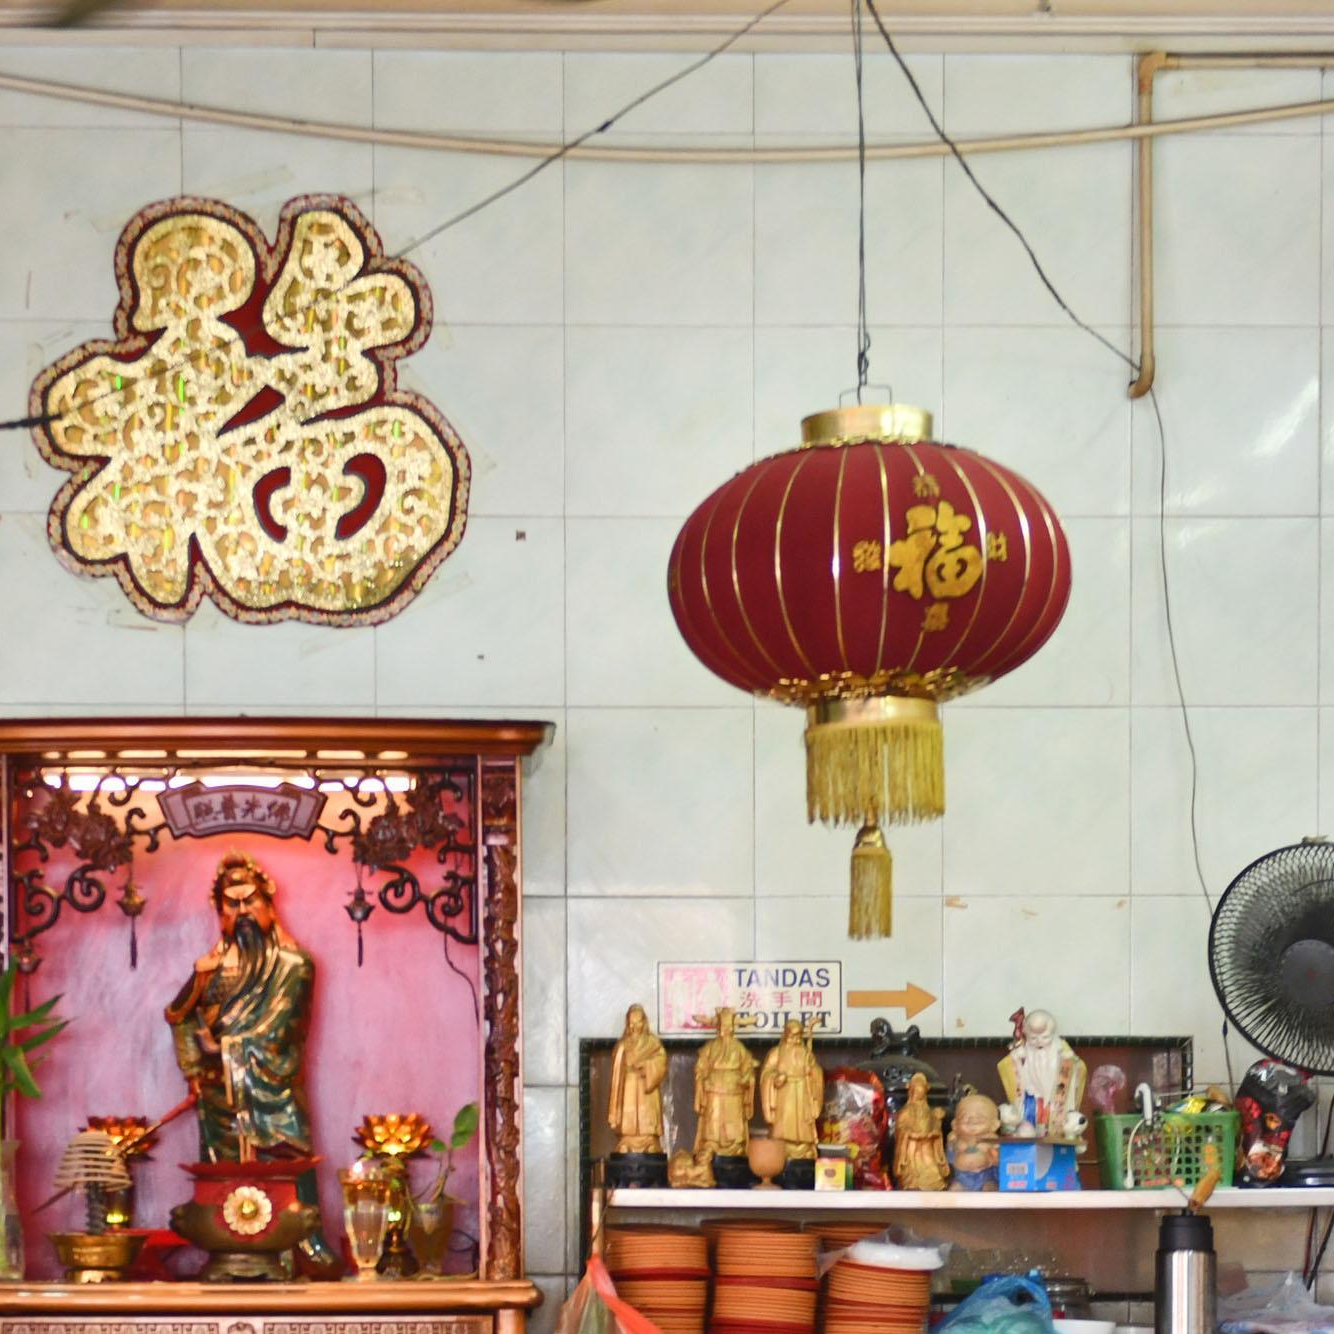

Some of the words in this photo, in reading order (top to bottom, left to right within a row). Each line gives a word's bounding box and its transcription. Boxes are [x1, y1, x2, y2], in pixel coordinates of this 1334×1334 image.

[46, 208, 457, 614] 福
[889, 500, 985, 600] 福
[734, 968, 831, 988] TANDAS
[740, 991, 823, 1009] 洗手間
